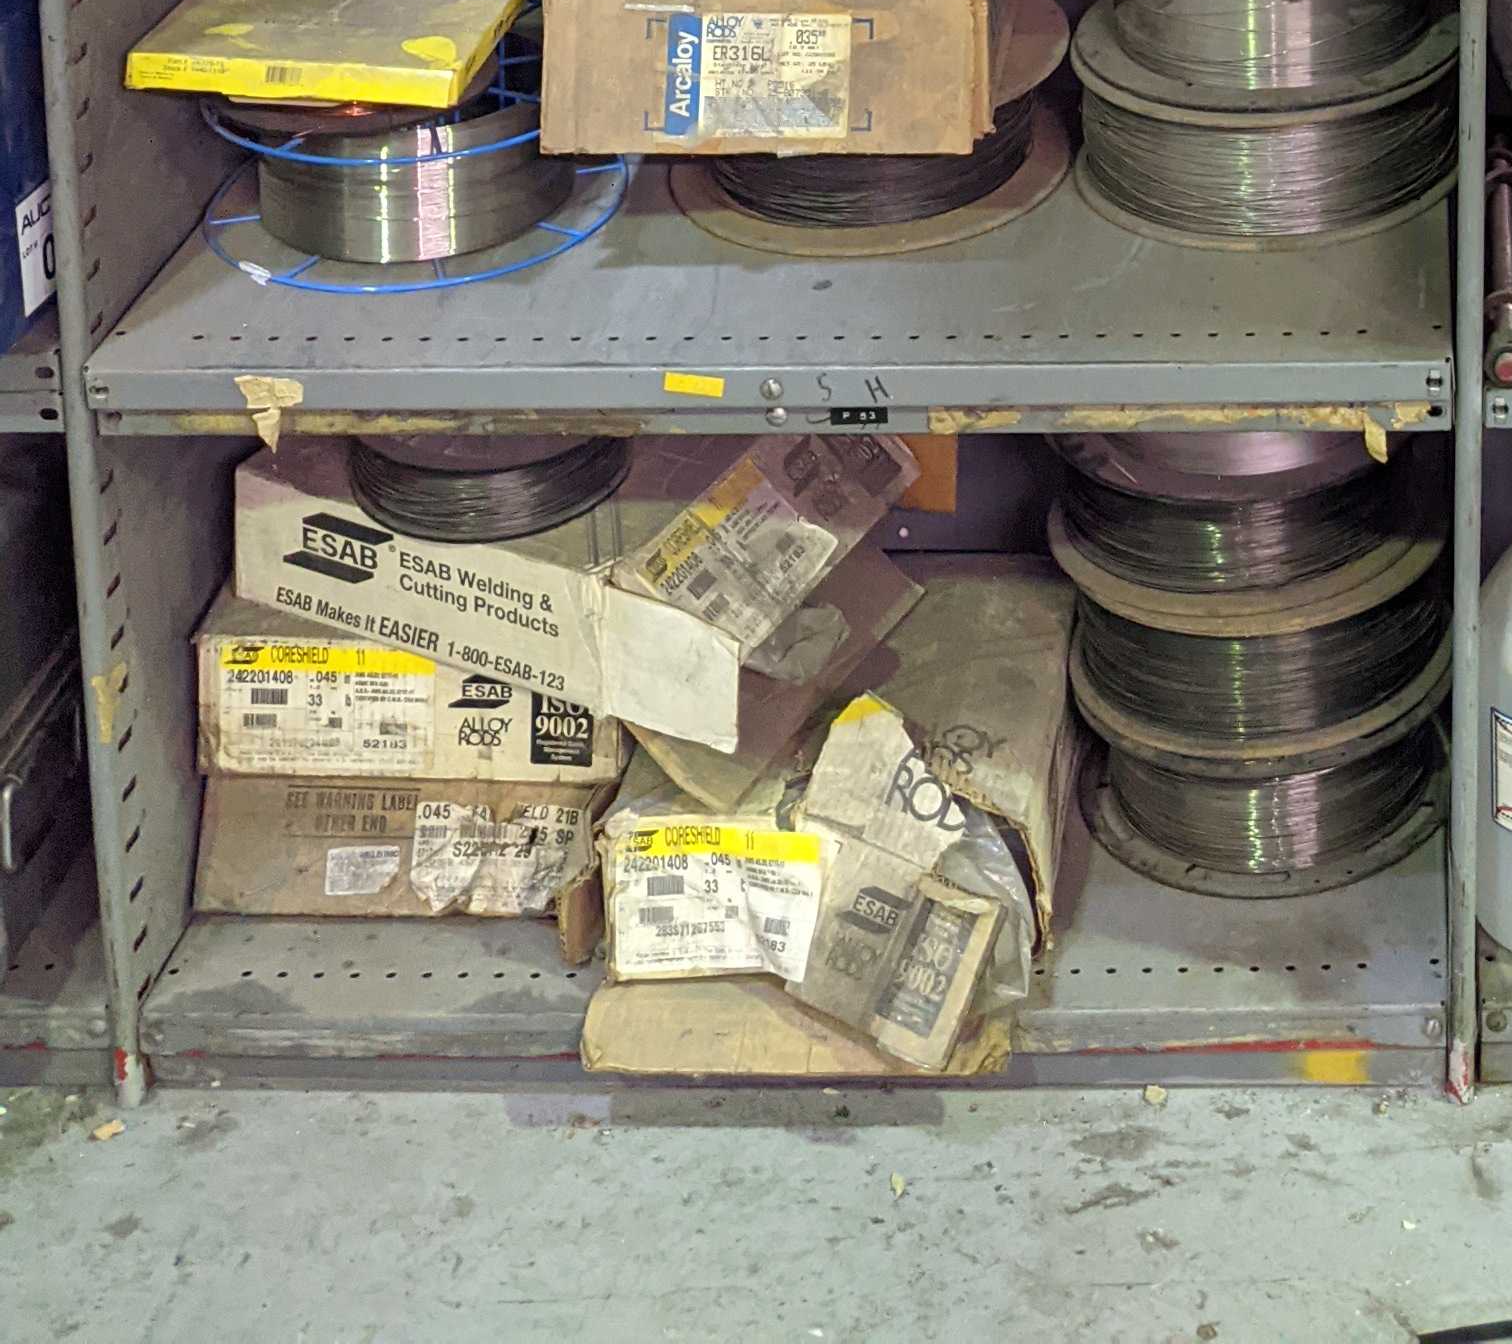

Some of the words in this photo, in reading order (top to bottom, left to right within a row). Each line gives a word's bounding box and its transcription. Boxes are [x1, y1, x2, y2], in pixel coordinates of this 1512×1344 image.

[707, 15, 745, 27] ALLOY
[706, 25, 737, 39] RODS
[712, 45, 772, 62] ER316L
[668, 30, 700, 118] Arcaloy
[21, 192, 52, 236] AUC
[301, 526, 379, 571] ESAB
[399, 550, 453, 581] ESAB
[457, 567, 534, 611] Welding
[539, 593, 554, 614] &
[399, 573, 468, 613] Cutting
[474, 594, 560, 638] Products
[276, 586, 313, 611] ESAB
[315, 598, 361, 629] Makes
[364, 614, 376, 633] It
[378, 616, 440, 653] EASIER
[447, 641, 567, 692] 1-800-ESAB-123
[270, 645, 329, 664] CORESHIELD
[356, 648, 367, 665] 11
[227, 669, 294, 684] 242201408
[308, 670, 338, 683] .045
[307, 693, 323, 707] 33
[461, 684, 513, 699] ESAB
[459, 716, 513, 733] ALLOY
[535, 716, 589, 739] 9002
[458, 729, 502, 747] RODS
[286, 792, 309, 809] SEE
[315, 792, 374, 811] WARNING
[883, 762, 966, 832] ROD
[360, 815, 388, 833] END
[418, 803, 451, 820] .045
[555, 807, 580, 826] 21B
[554, 828, 575, 846] SP
[664, 826, 720, 847] CORESHIELD
[623, 854, 689, 874] 242201408
[704, 852, 732, 866] .045
[703, 879, 719, 894] 33
[852, 894, 900, 930] ESAB
